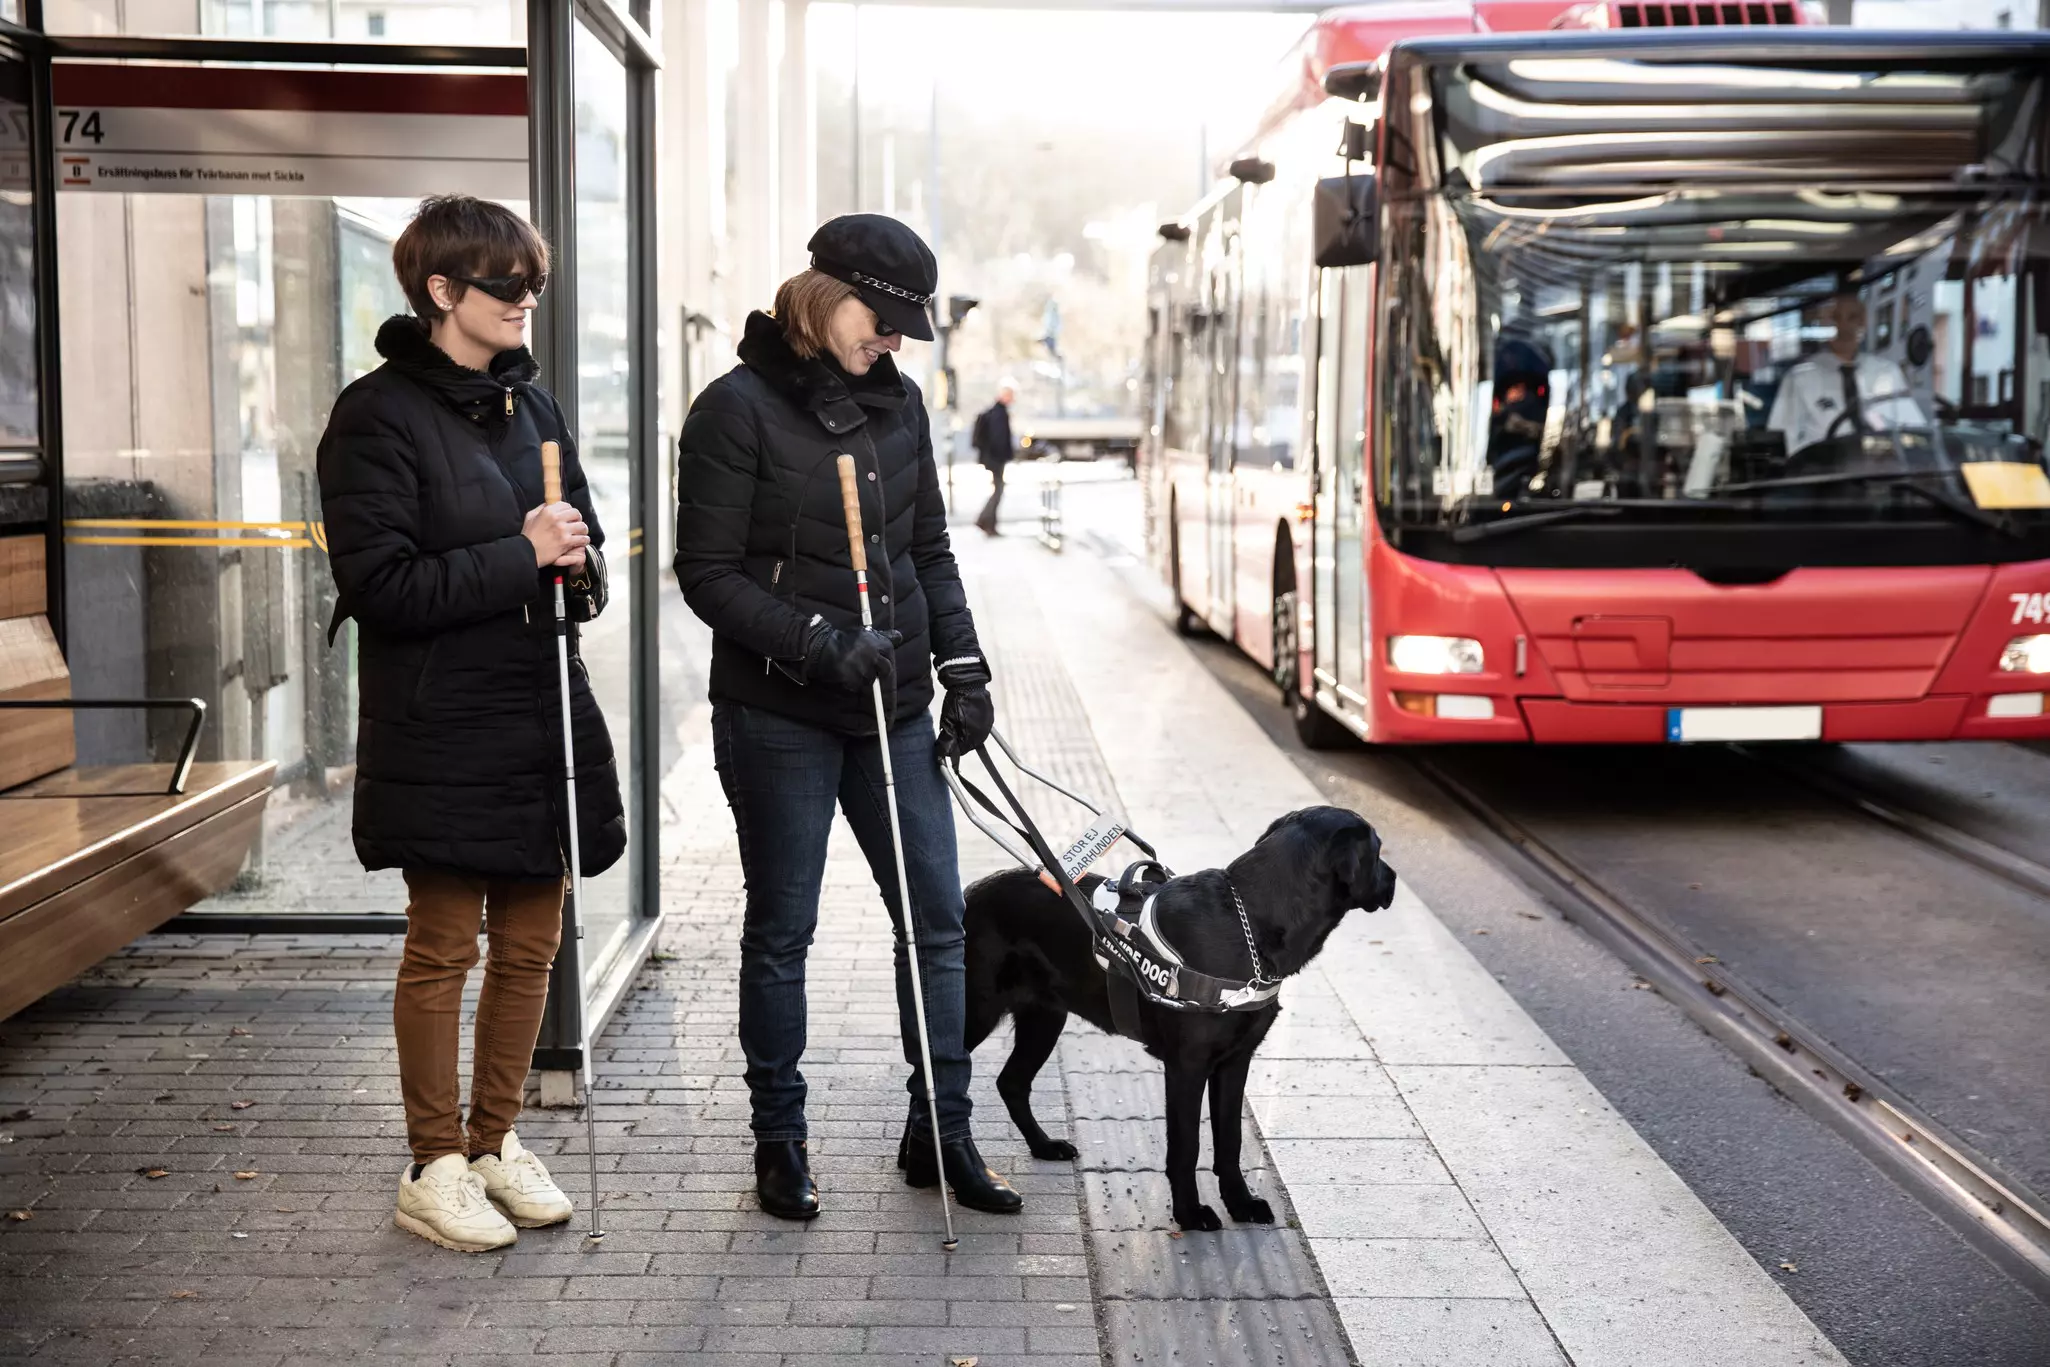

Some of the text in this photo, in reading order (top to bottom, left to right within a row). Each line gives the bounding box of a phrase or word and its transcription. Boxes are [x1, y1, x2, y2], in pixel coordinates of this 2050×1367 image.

[58, 110, 105, 144] 74
[274, 170, 305, 181] Sickla
[1062, 828, 1099, 863] STÖR EJ
[1066, 823, 1124, 880] EDARHUNDEN
[1140, 957, 1170, 987] DOG
